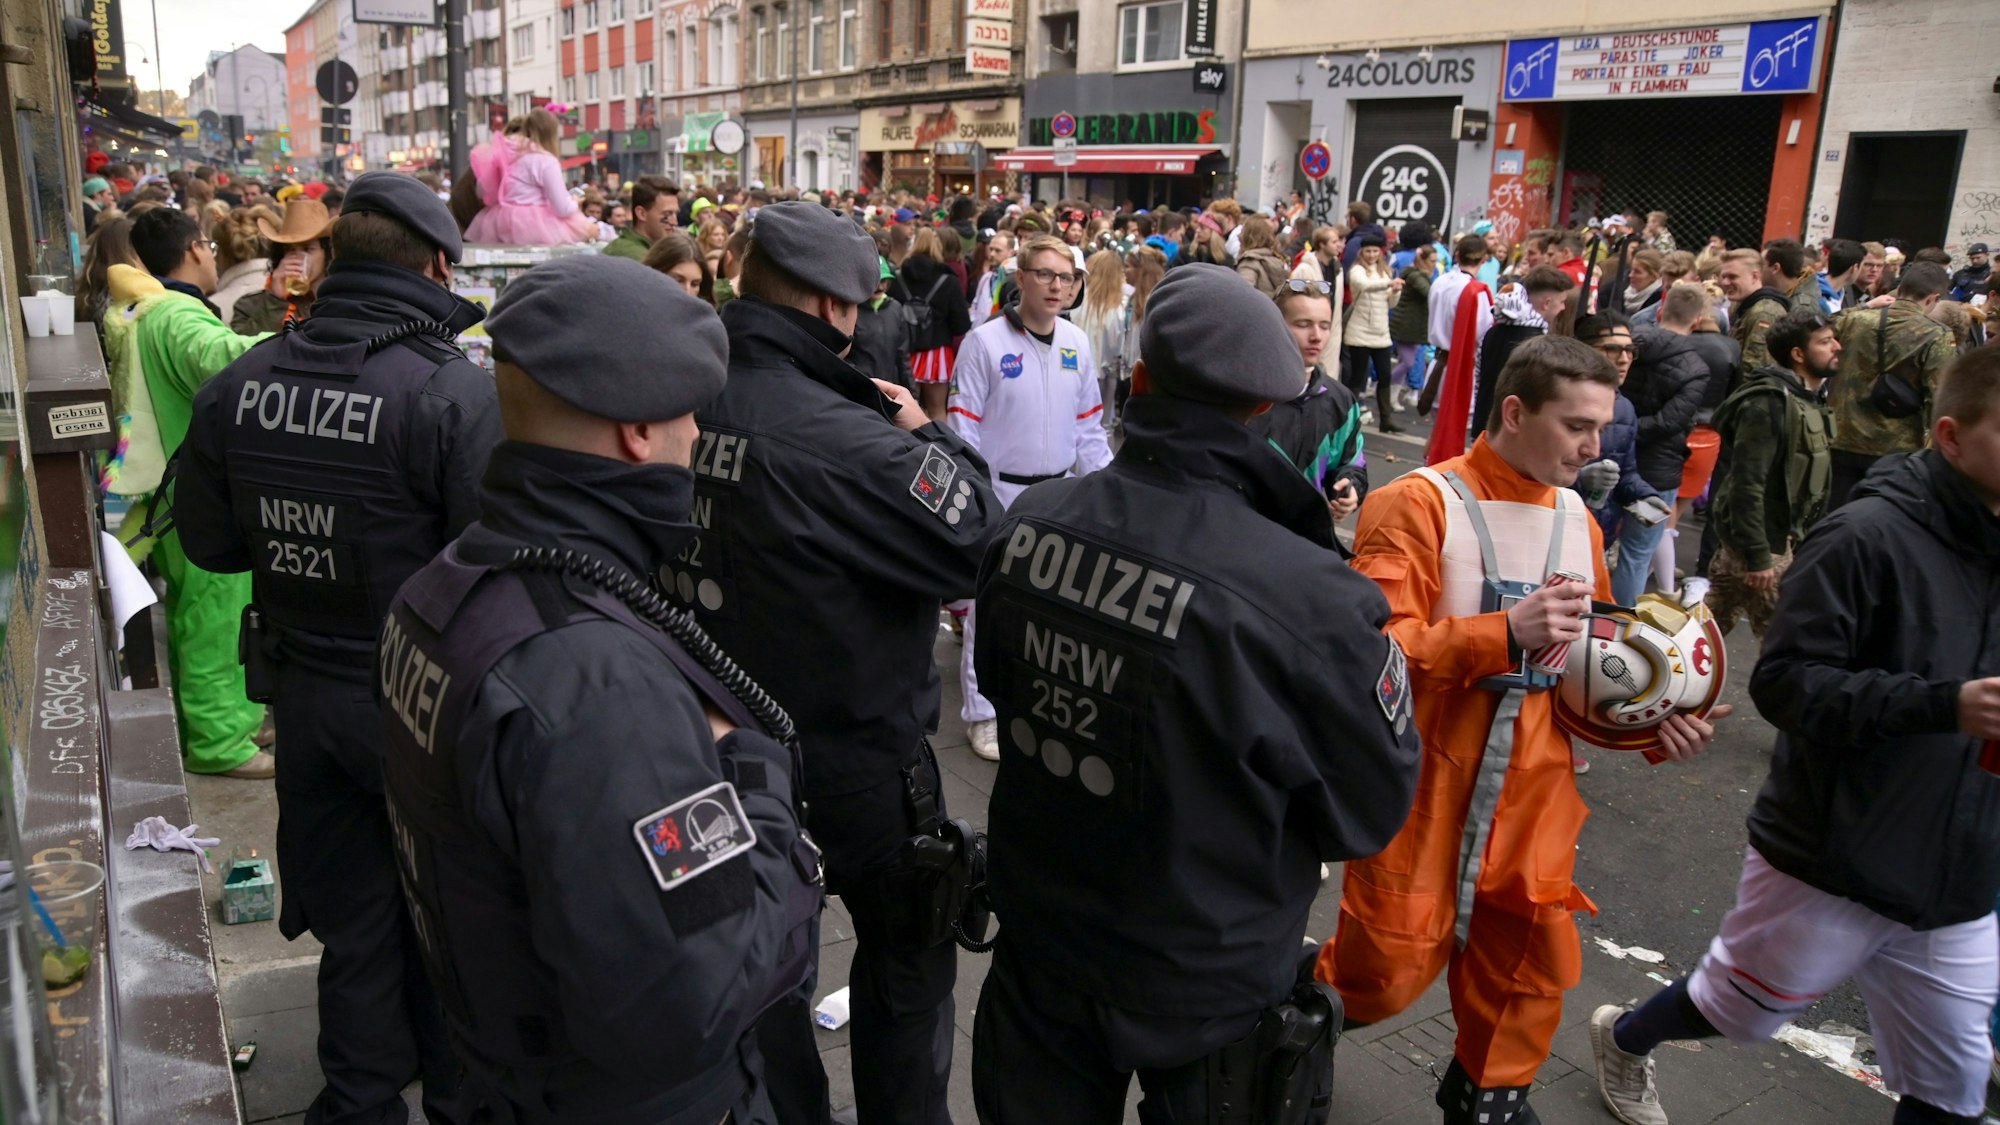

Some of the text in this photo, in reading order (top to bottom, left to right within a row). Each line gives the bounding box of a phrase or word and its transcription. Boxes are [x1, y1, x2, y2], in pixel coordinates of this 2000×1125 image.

[90, 0, 112, 54] Golda
[975, 25, 1008, 41] ברכה
[1196, 0, 1209, 43] HILLE
[1573, 29, 1720, 51] LARA DEUTSCHSTUNDE
[1600, 44, 1724, 65] PARASITE JOKER
[1751, 23, 1813, 88] OFF
[1200, 68, 1223, 88] sky
[1327, 57, 1475, 88] 24COLOURS
[1508, 42, 1555, 96] OFF
[1572, 61, 1711, 81] PORTRAIT EINER FRAU
[1608, 79, 1689, 94] IN FLAMMEN
[881, 125, 914, 141] FALAFEL
[959, 122, 1017, 139] SCHAWARMA
[1380, 165, 1429, 192] 24C
[1375, 192, 1429, 219] OLO
[1001, 361, 1021, 369] NASA
[55, 421, 104, 434] Cesena
[235, 380, 383, 444] POLIZEI
[260, 496, 335, 537] NRW
[267, 540, 337, 580] 2521
[1000, 523, 1195, 640] POLIZEI
[1024, 620, 1124, 695] NRW
[381, 611, 451, 755] POLIZEI
[1031, 679, 1098, 741] 252
